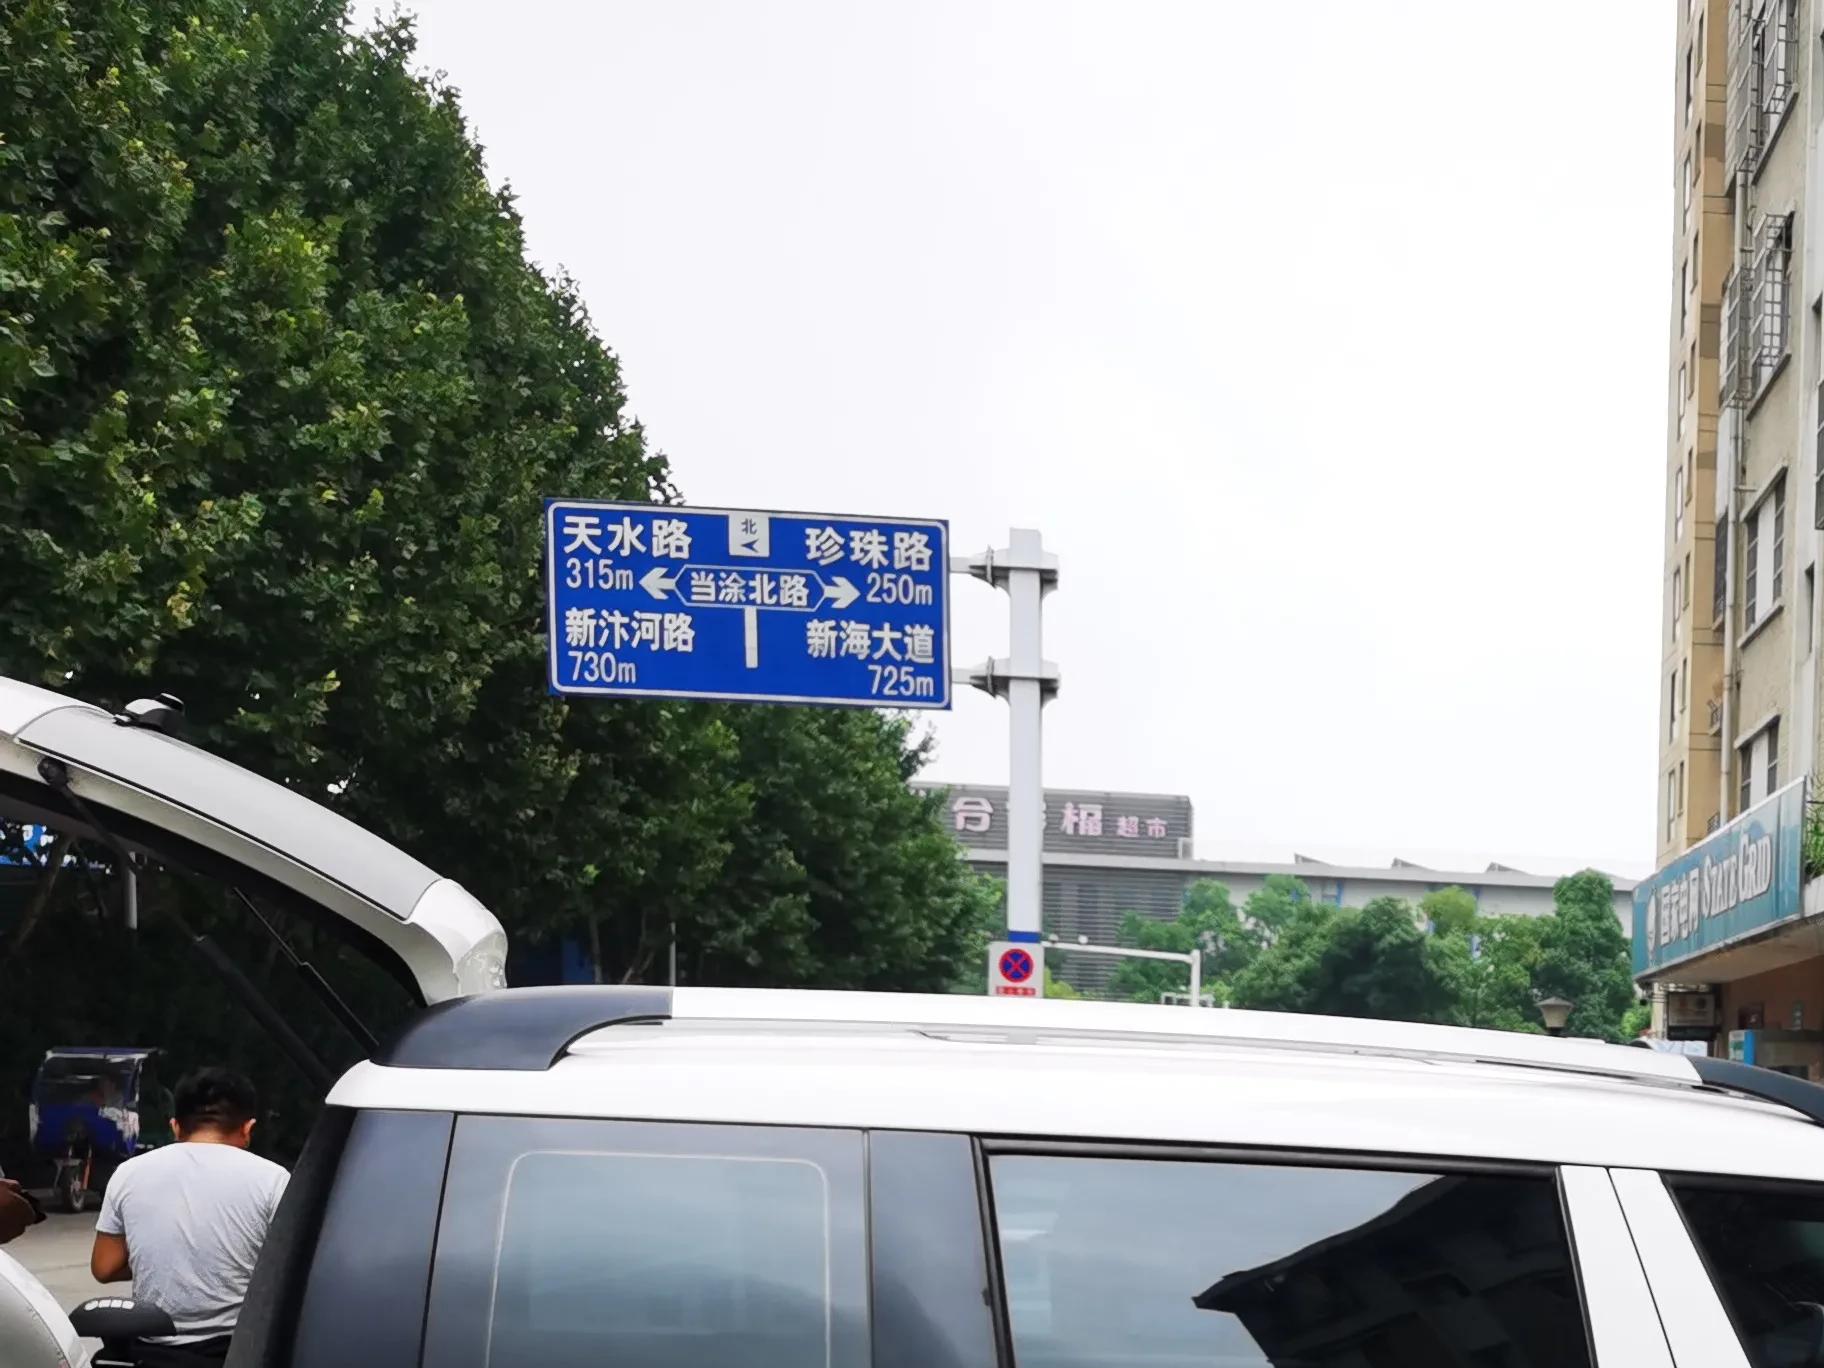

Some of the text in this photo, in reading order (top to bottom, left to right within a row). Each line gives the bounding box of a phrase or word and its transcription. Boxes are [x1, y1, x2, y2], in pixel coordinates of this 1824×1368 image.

[563, 515, 692, 559] 天水路
[740, 517, 758, 536] 北
[805, 527, 933, 572] 珍珠路
[566, 559, 634, 591] 315m
[690, 572, 810, 607] 当涂北路
[866, 572, 933, 606] 250m
[565, 607, 695, 653] 新汴河路
[806, 619, 935, 664] 新海大道
[567, 650, 636, 684] 730m
[868, 664, 935, 697] 725m
[952, 797, 1169, 839] 合福 超市
